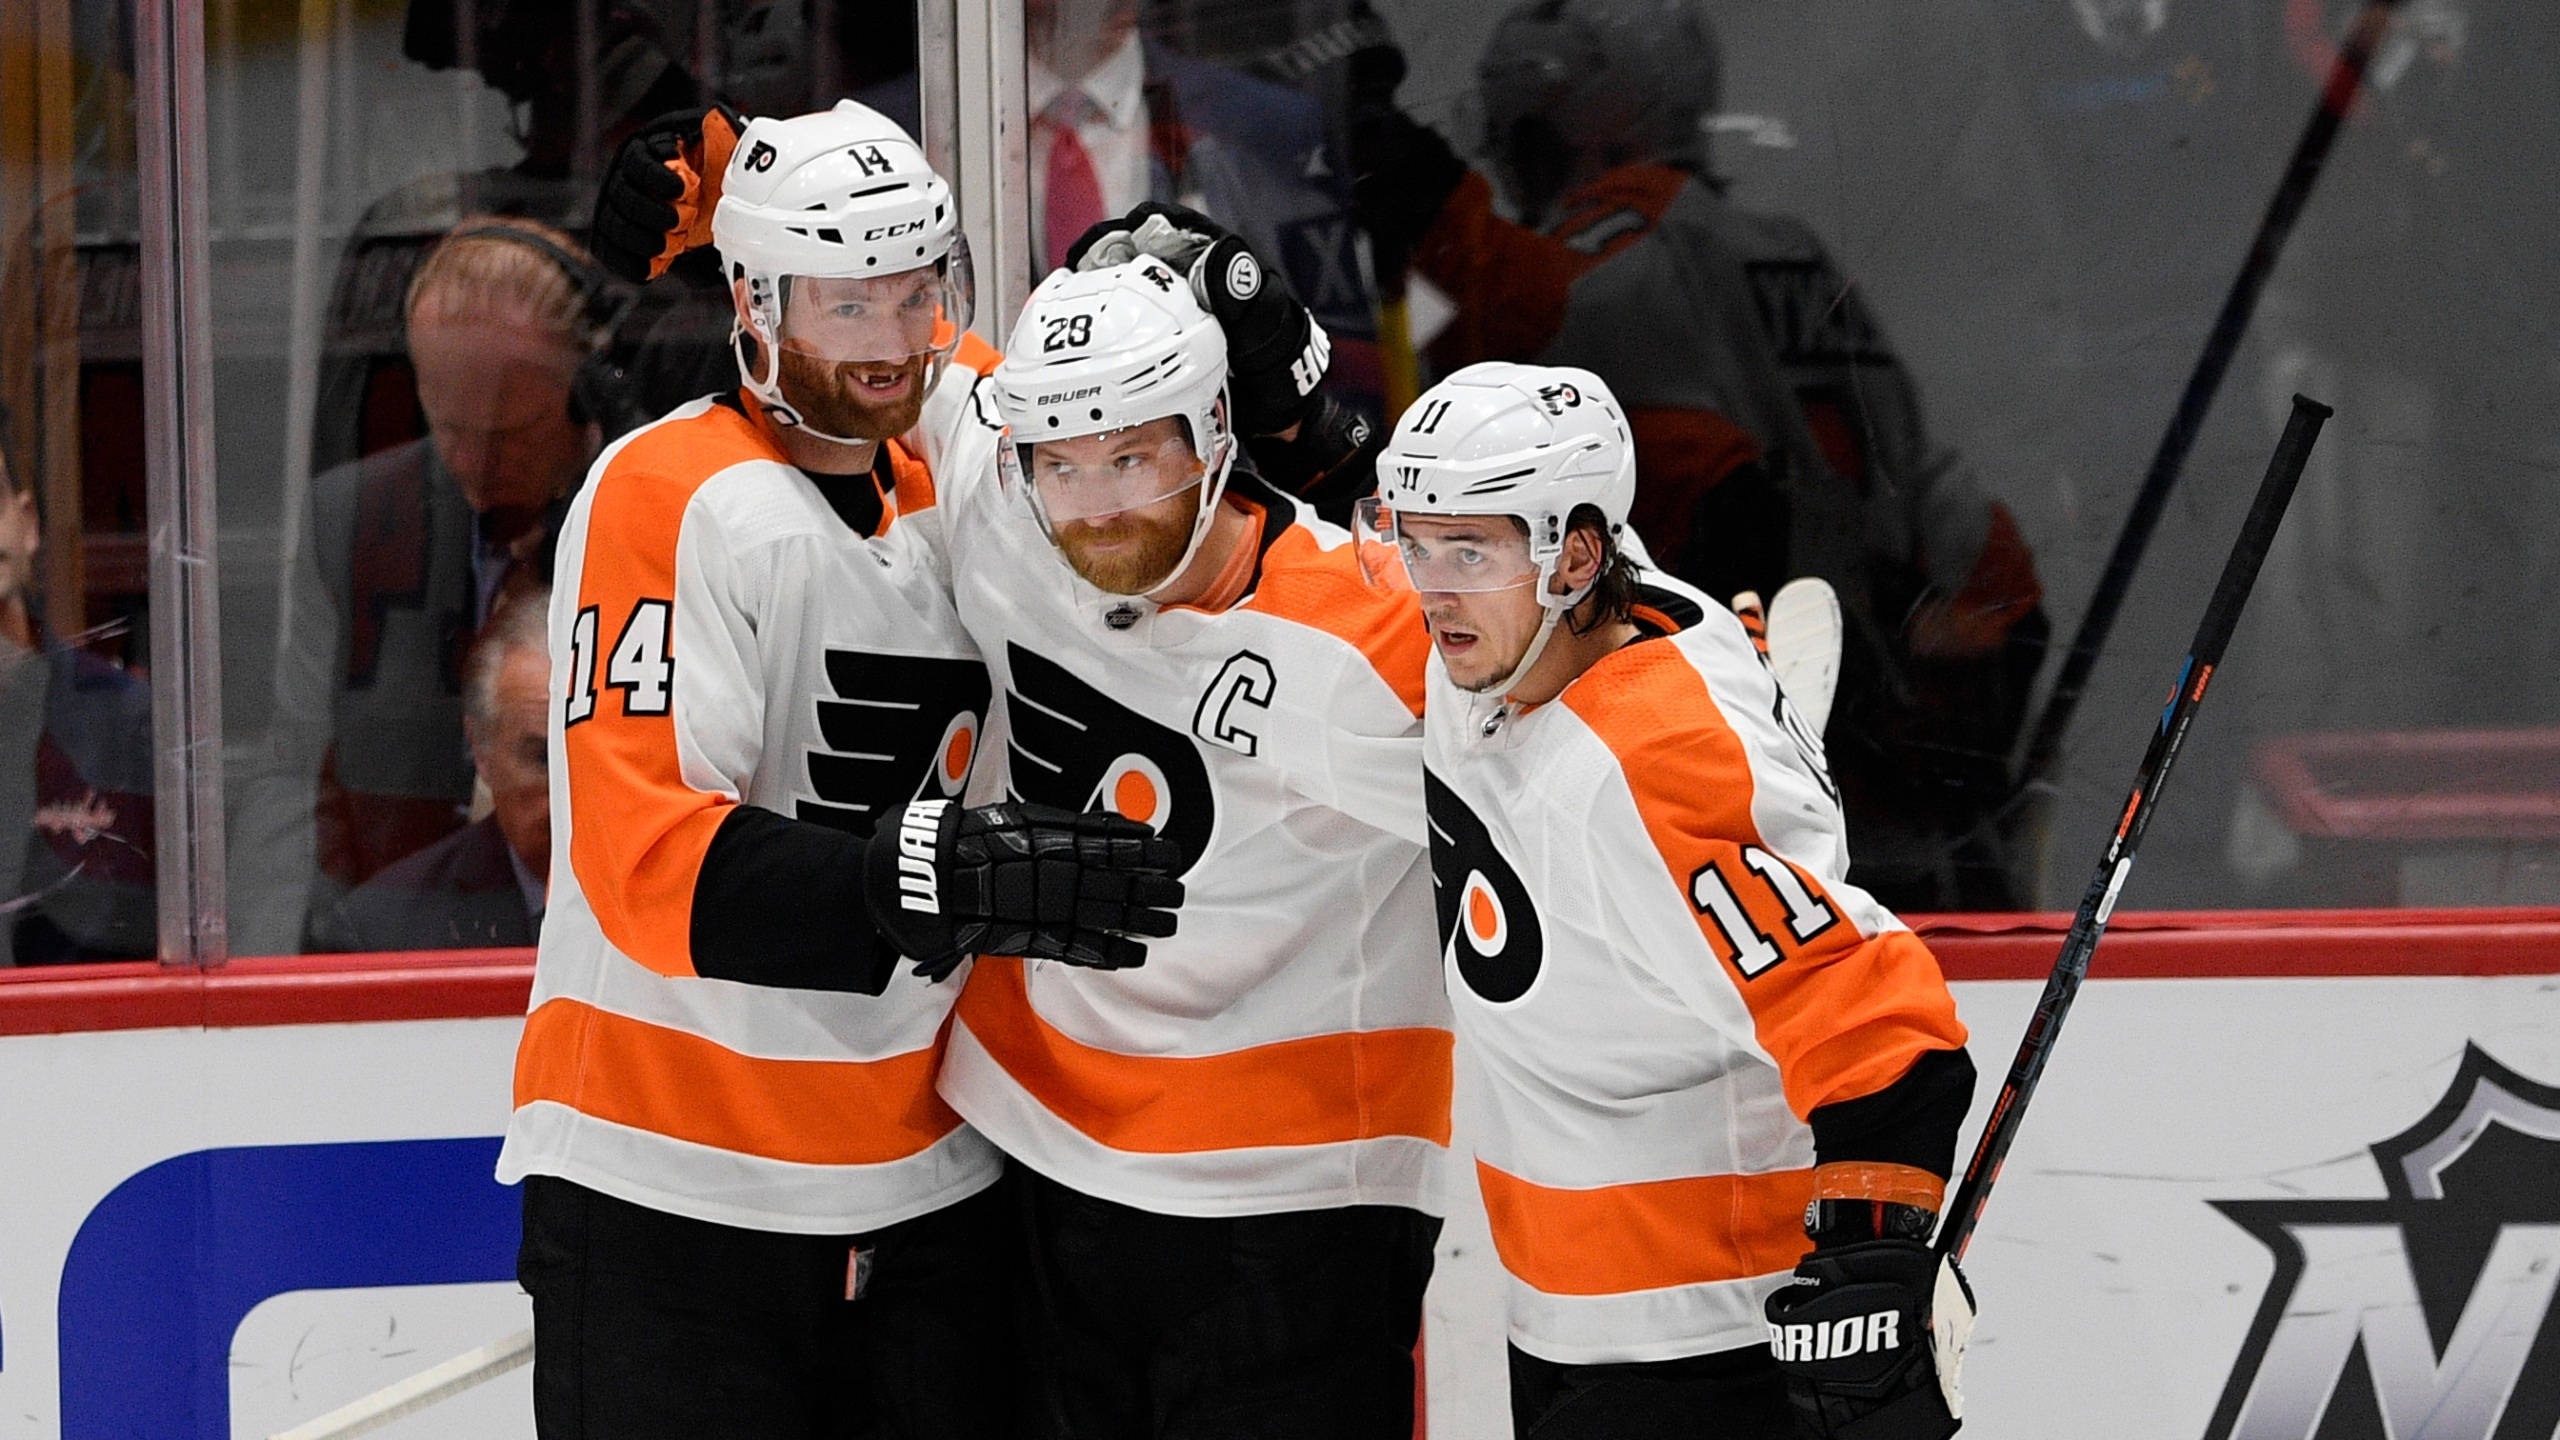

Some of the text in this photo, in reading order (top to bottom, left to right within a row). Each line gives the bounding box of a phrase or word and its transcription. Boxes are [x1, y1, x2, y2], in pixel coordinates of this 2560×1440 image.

[848, 145, 894, 177] 14
[864, 218, 925, 240] CCM
[1043, 314, 1093, 353] 28
[1037, 385, 1101, 406] BAUER
[1410, 399, 1452, 434] 11
[565, 597, 675, 729] 14
[1192, 649, 1277, 757] C
[898, 799, 950, 914] WAR
[1688, 843, 1840, 982] 11
